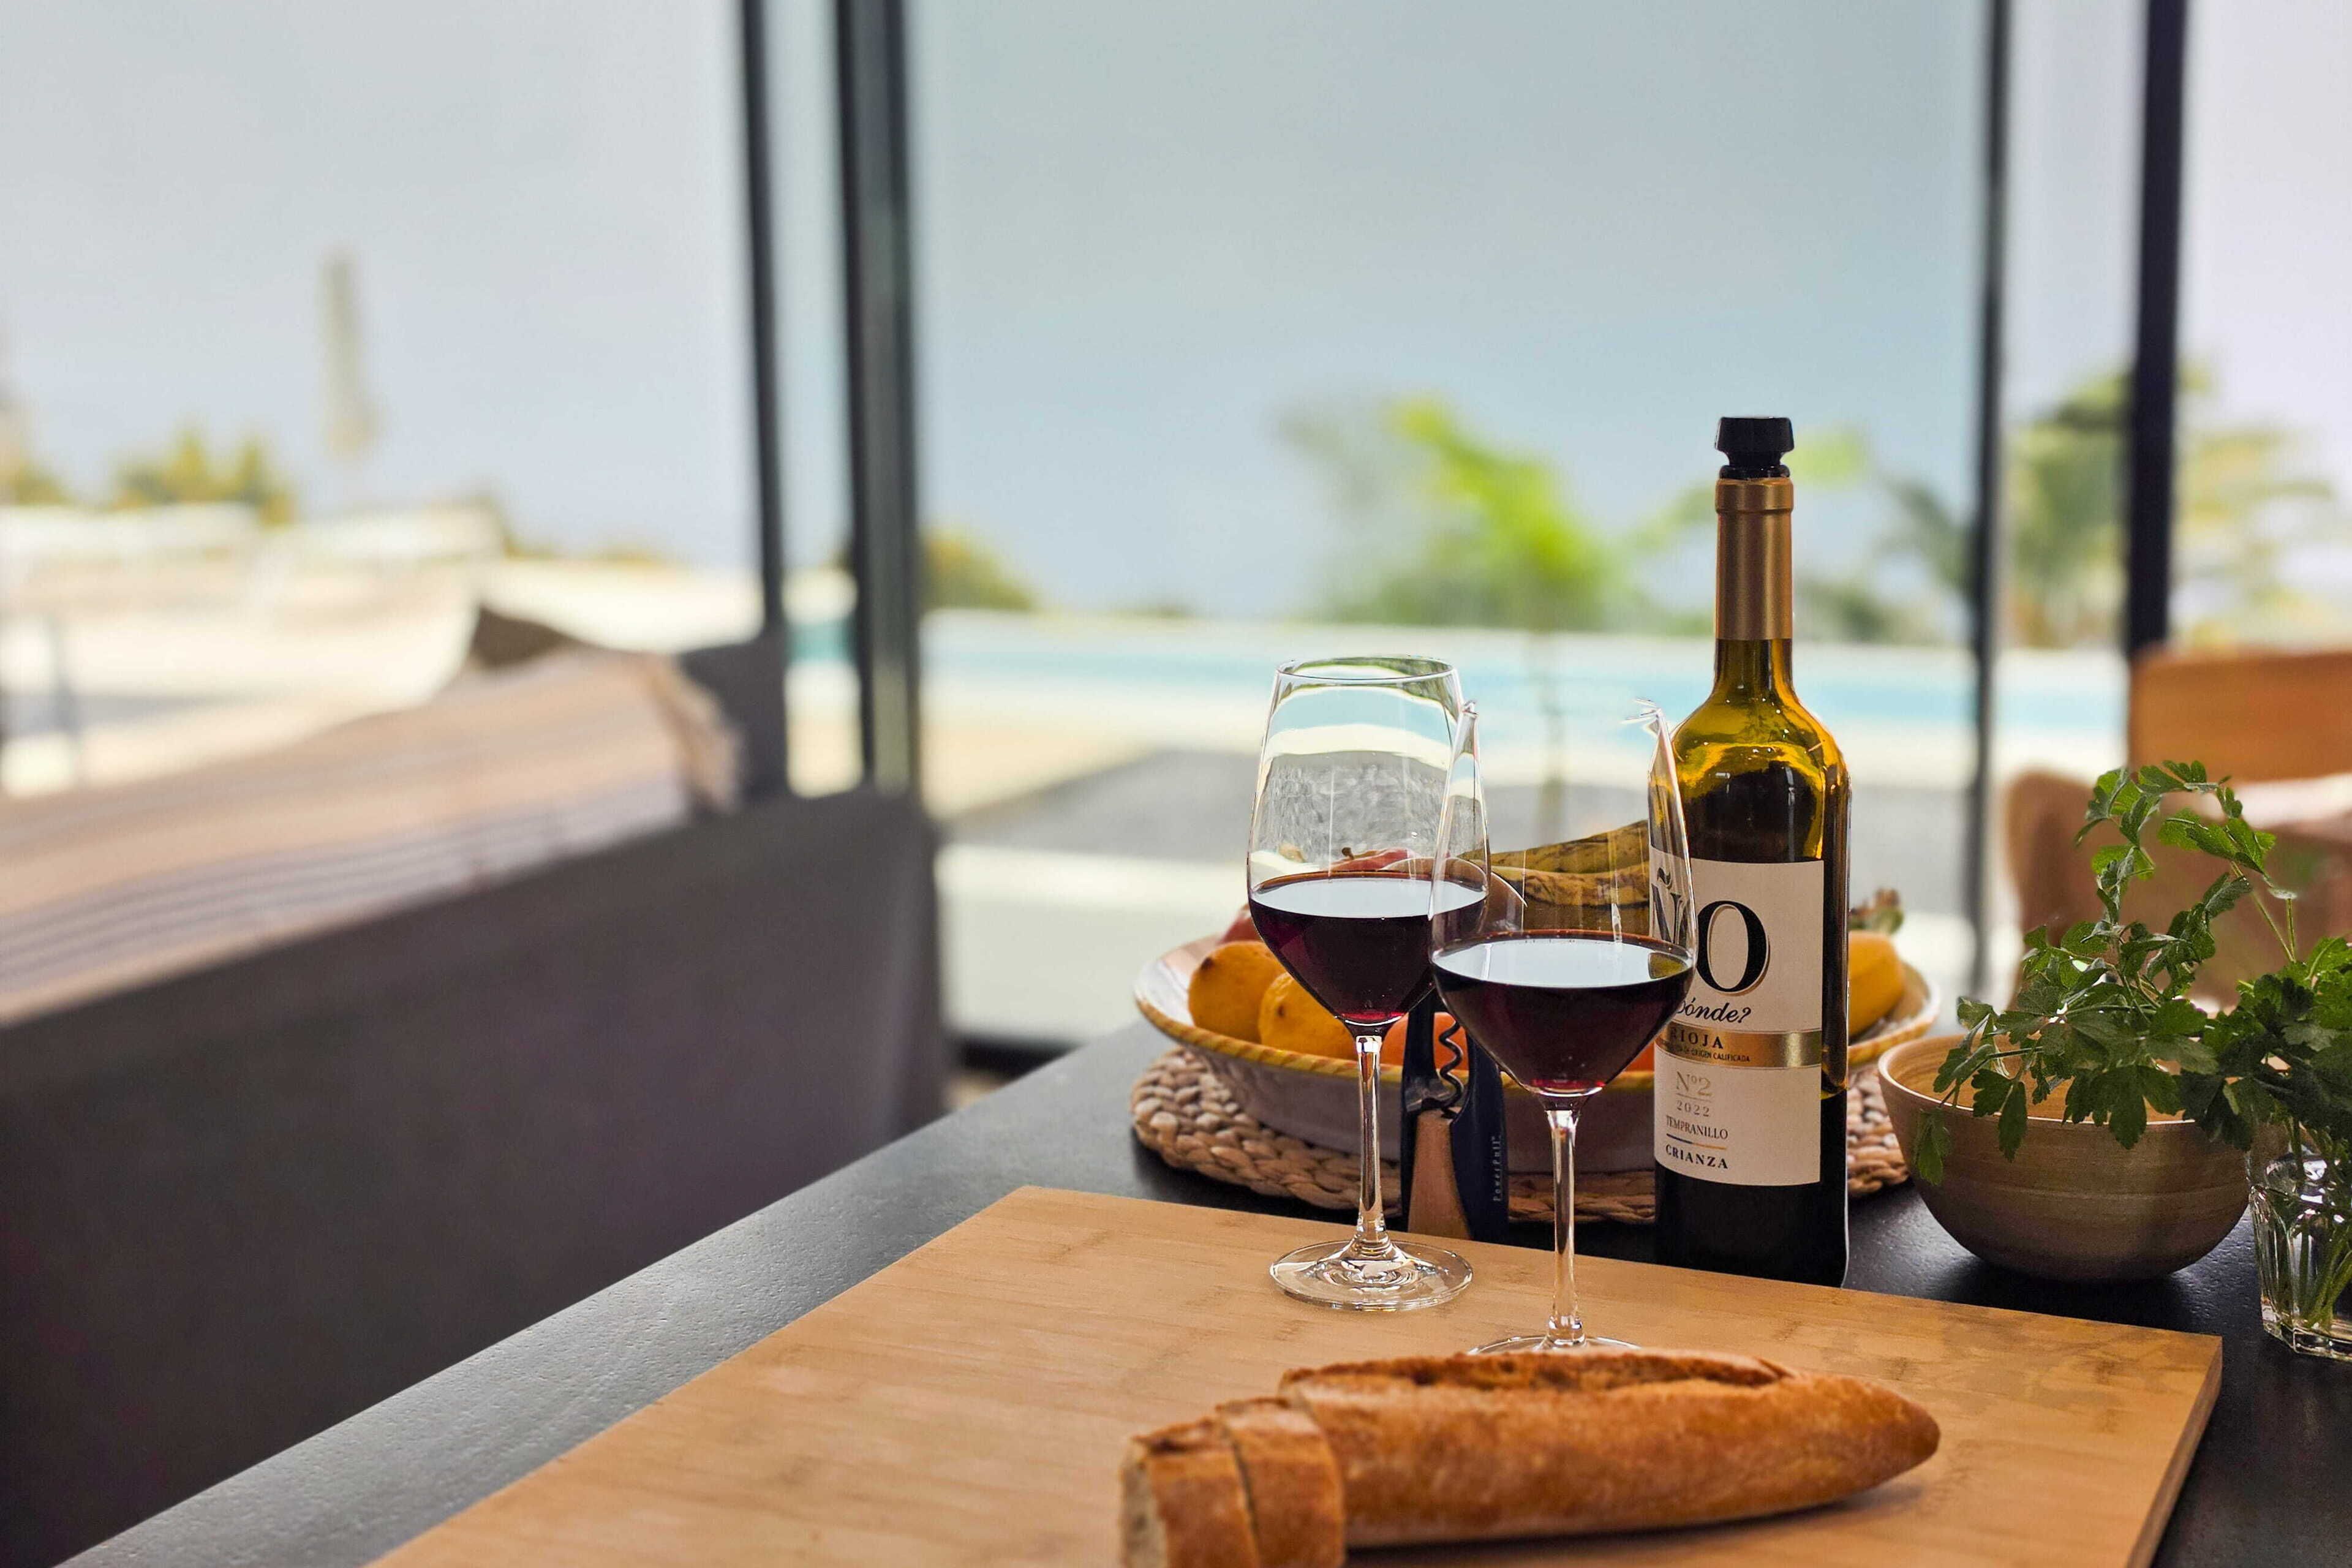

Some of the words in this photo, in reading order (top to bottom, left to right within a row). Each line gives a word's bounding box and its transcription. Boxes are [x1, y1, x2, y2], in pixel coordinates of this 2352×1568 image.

[1670, 1026, 1724, 1049] RIOJA
[1713, 1052, 1751, 1062] CALIFICADA
[1676, 1100, 1709, 1117] 2022
[1666, 1114, 1728, 1140] TEMPRANILLO
[1665, 1144, 1728, 1169] CRIANZA
